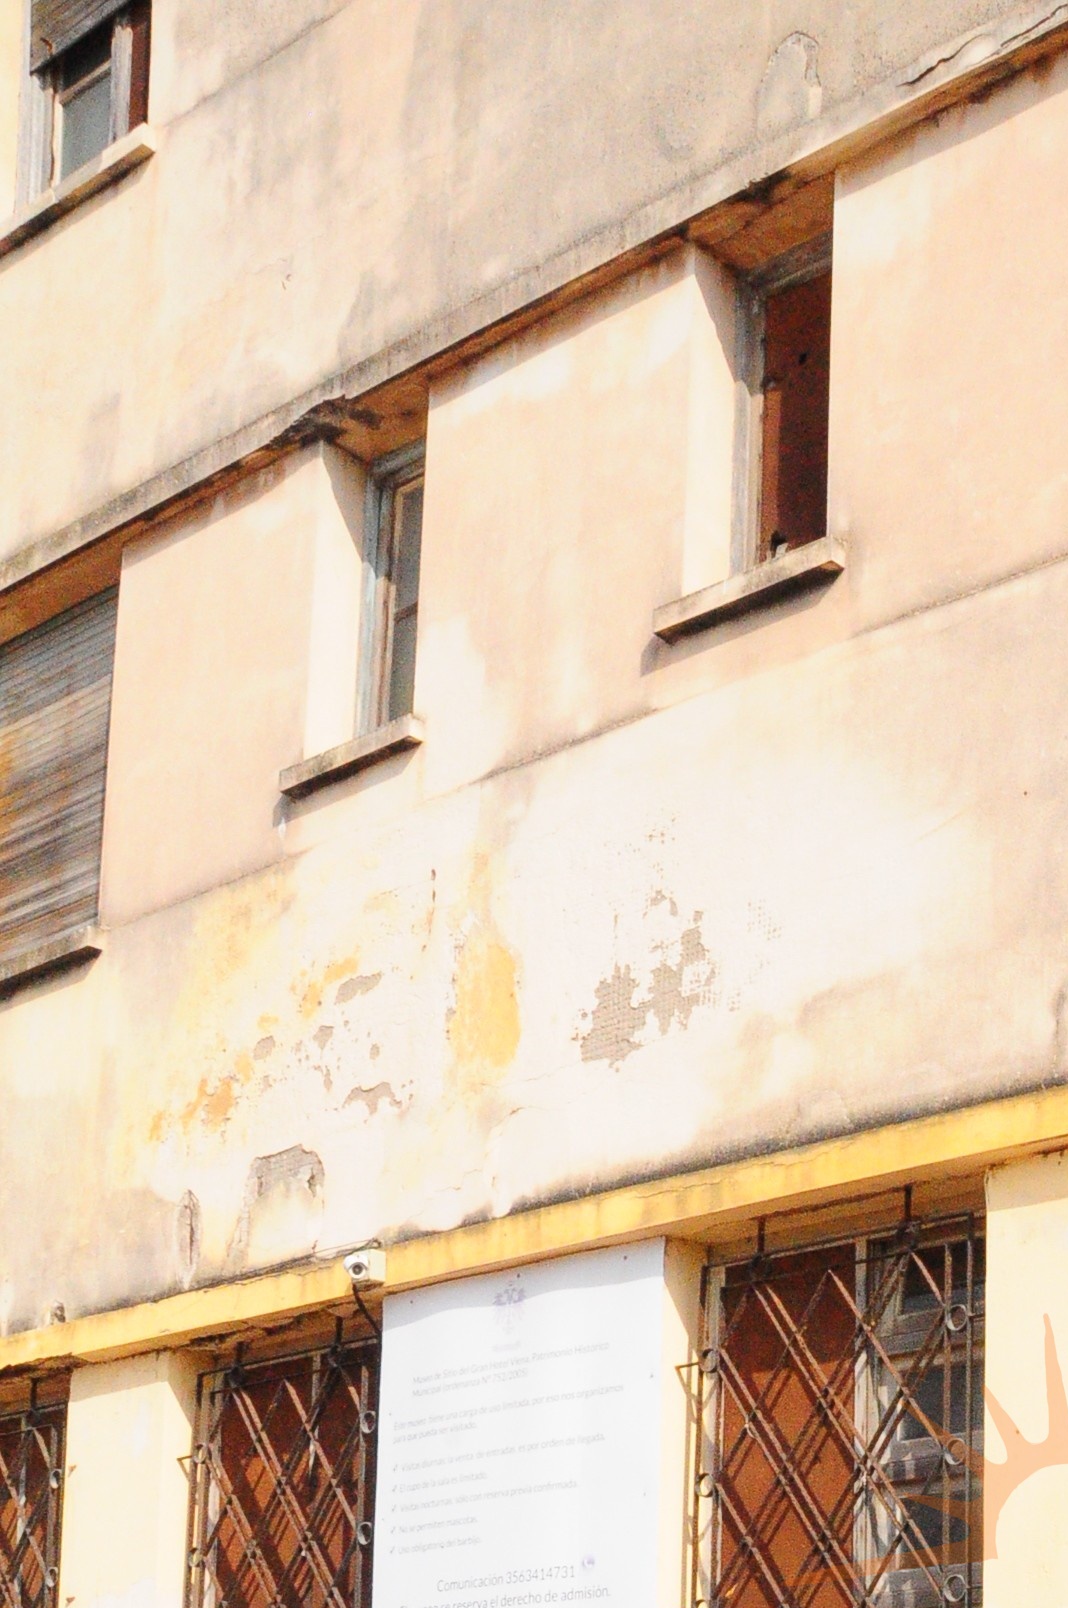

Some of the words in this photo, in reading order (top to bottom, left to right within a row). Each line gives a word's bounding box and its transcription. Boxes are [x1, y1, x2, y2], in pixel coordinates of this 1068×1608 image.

[459, 1366, 468, 1374] del
[470, 1362, 488, 1372] Gran
[490, 1358, 508, 1369] Hotel
[531, 1346, 572, 1361] Patrimonio
[459, 1409, 476, 1419] carga
[478, 1406, 487, 1414] de
[532, 1397, 543, 1406] por
[561, 1392, 574, 1400] nos
[575, 1384, 623, 1400] organizamos
[541, 1438, 563, 1448] orden
[565, 1436, 575, 1444] de
[436, 1573, 503, 1591] Comunicación
[505, 1565, 574, 1583] 3563414731
[490, 1596, 498, 1607] el
[500, 1591, 541, 1606] derecho
[544, 1589, 557, 1602] de
